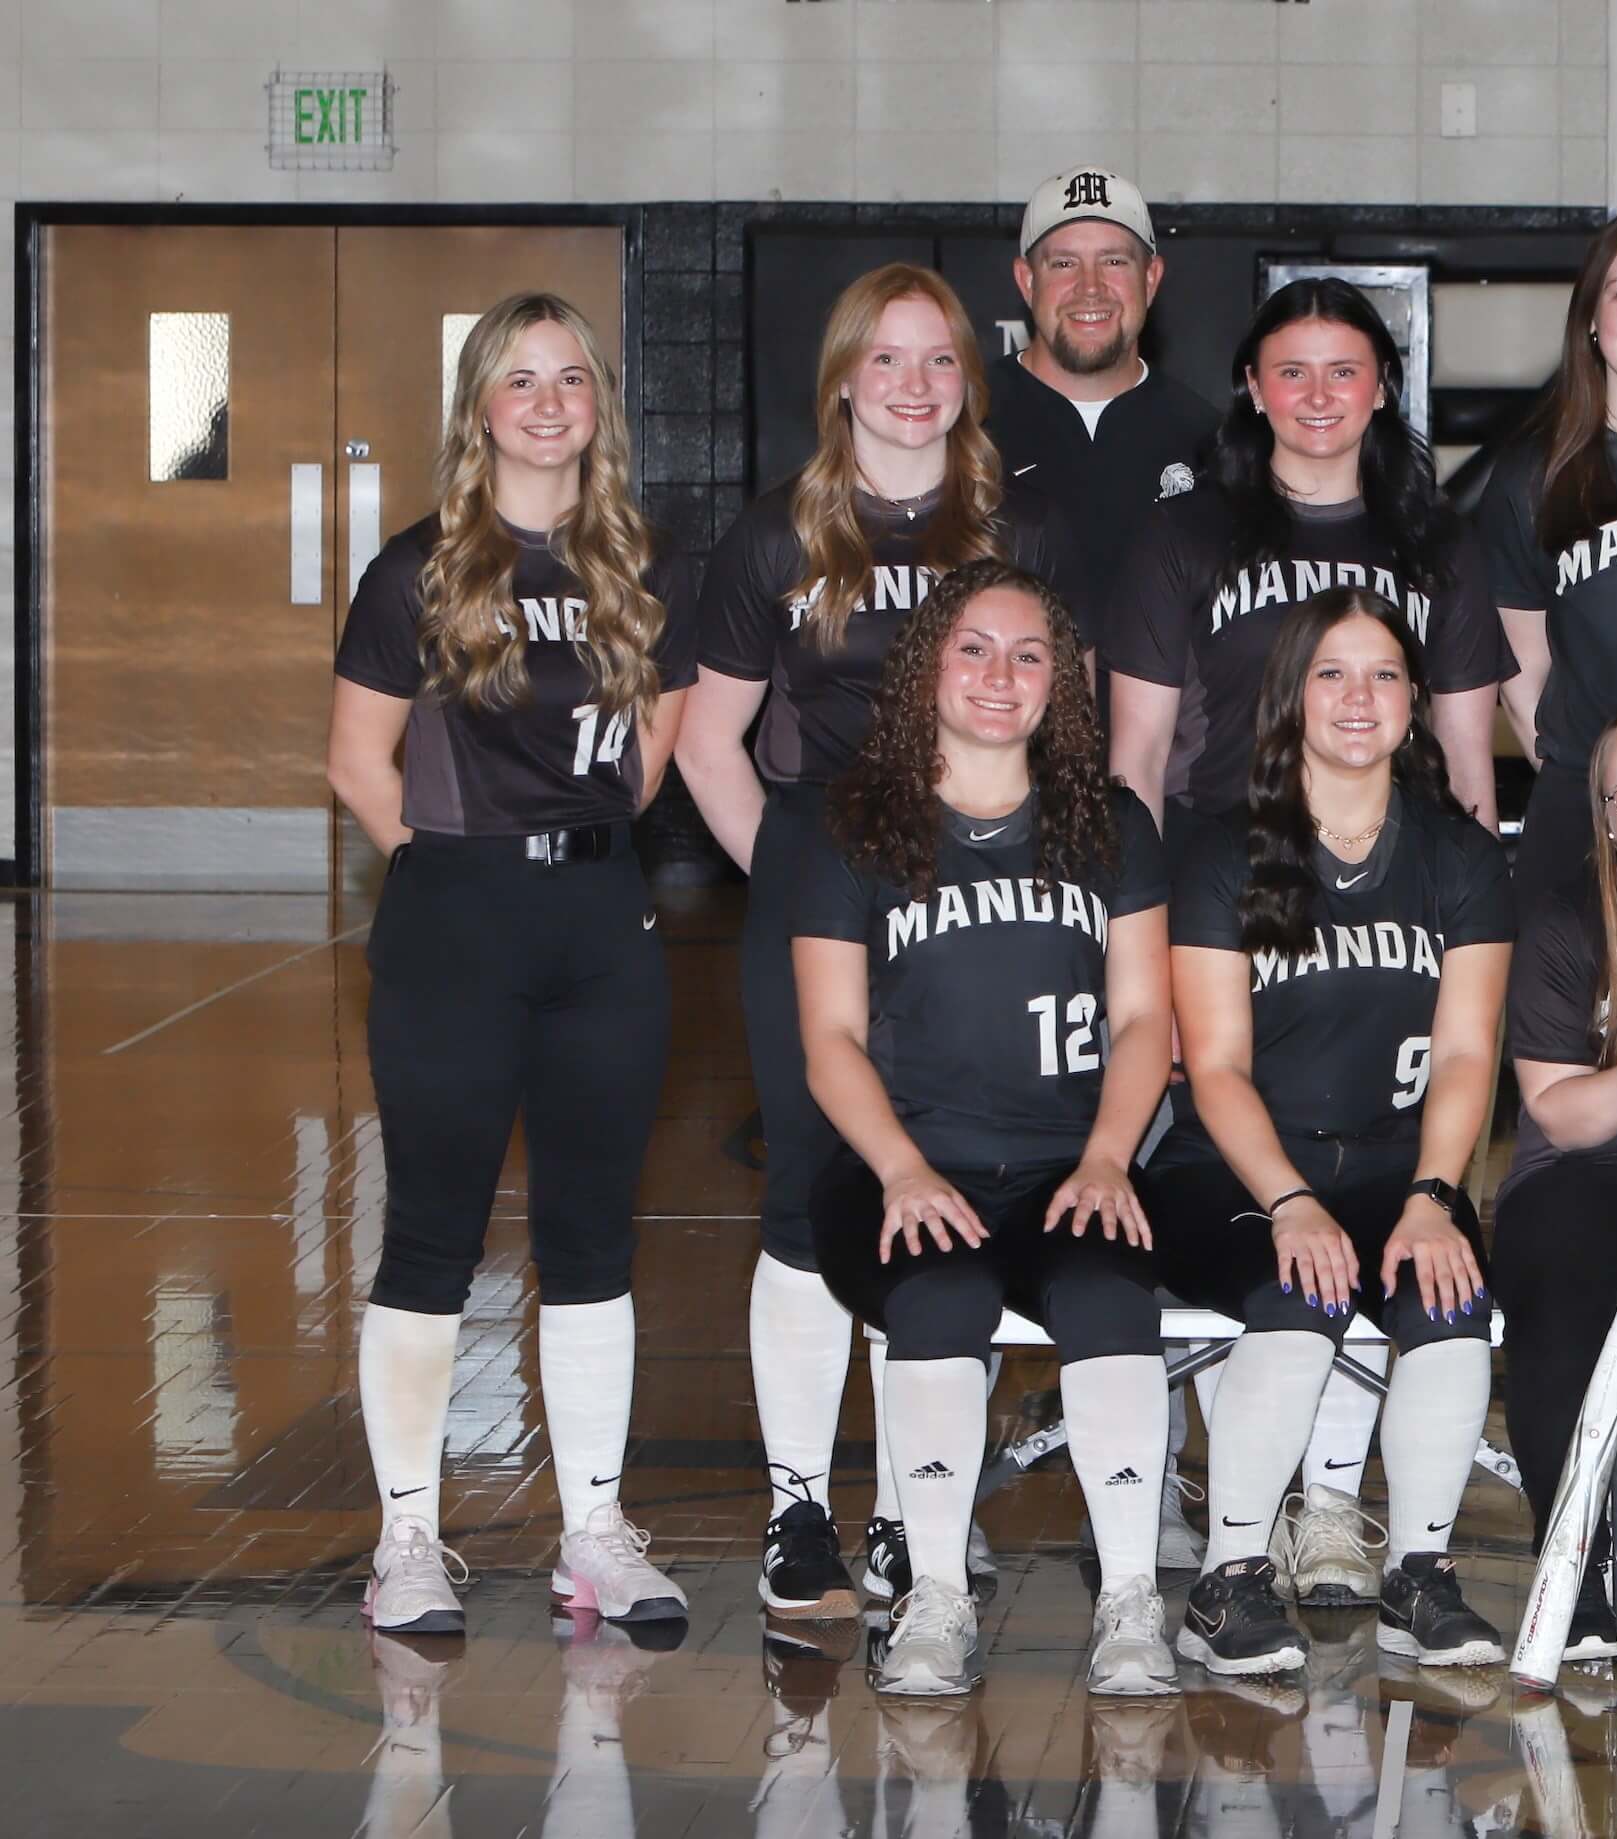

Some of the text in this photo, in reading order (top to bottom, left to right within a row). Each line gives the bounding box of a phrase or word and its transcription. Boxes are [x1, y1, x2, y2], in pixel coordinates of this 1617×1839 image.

[294, 89, 367, 144] EXIT
[571, 703, 632, 776] 14
[886, 878, 1109, 962] MANDAN
[1252, 922, 1444, 994] MANDA
[1028, 993, 1099, 1077] 12
[1391, 1036, 1432, 1110] 9
